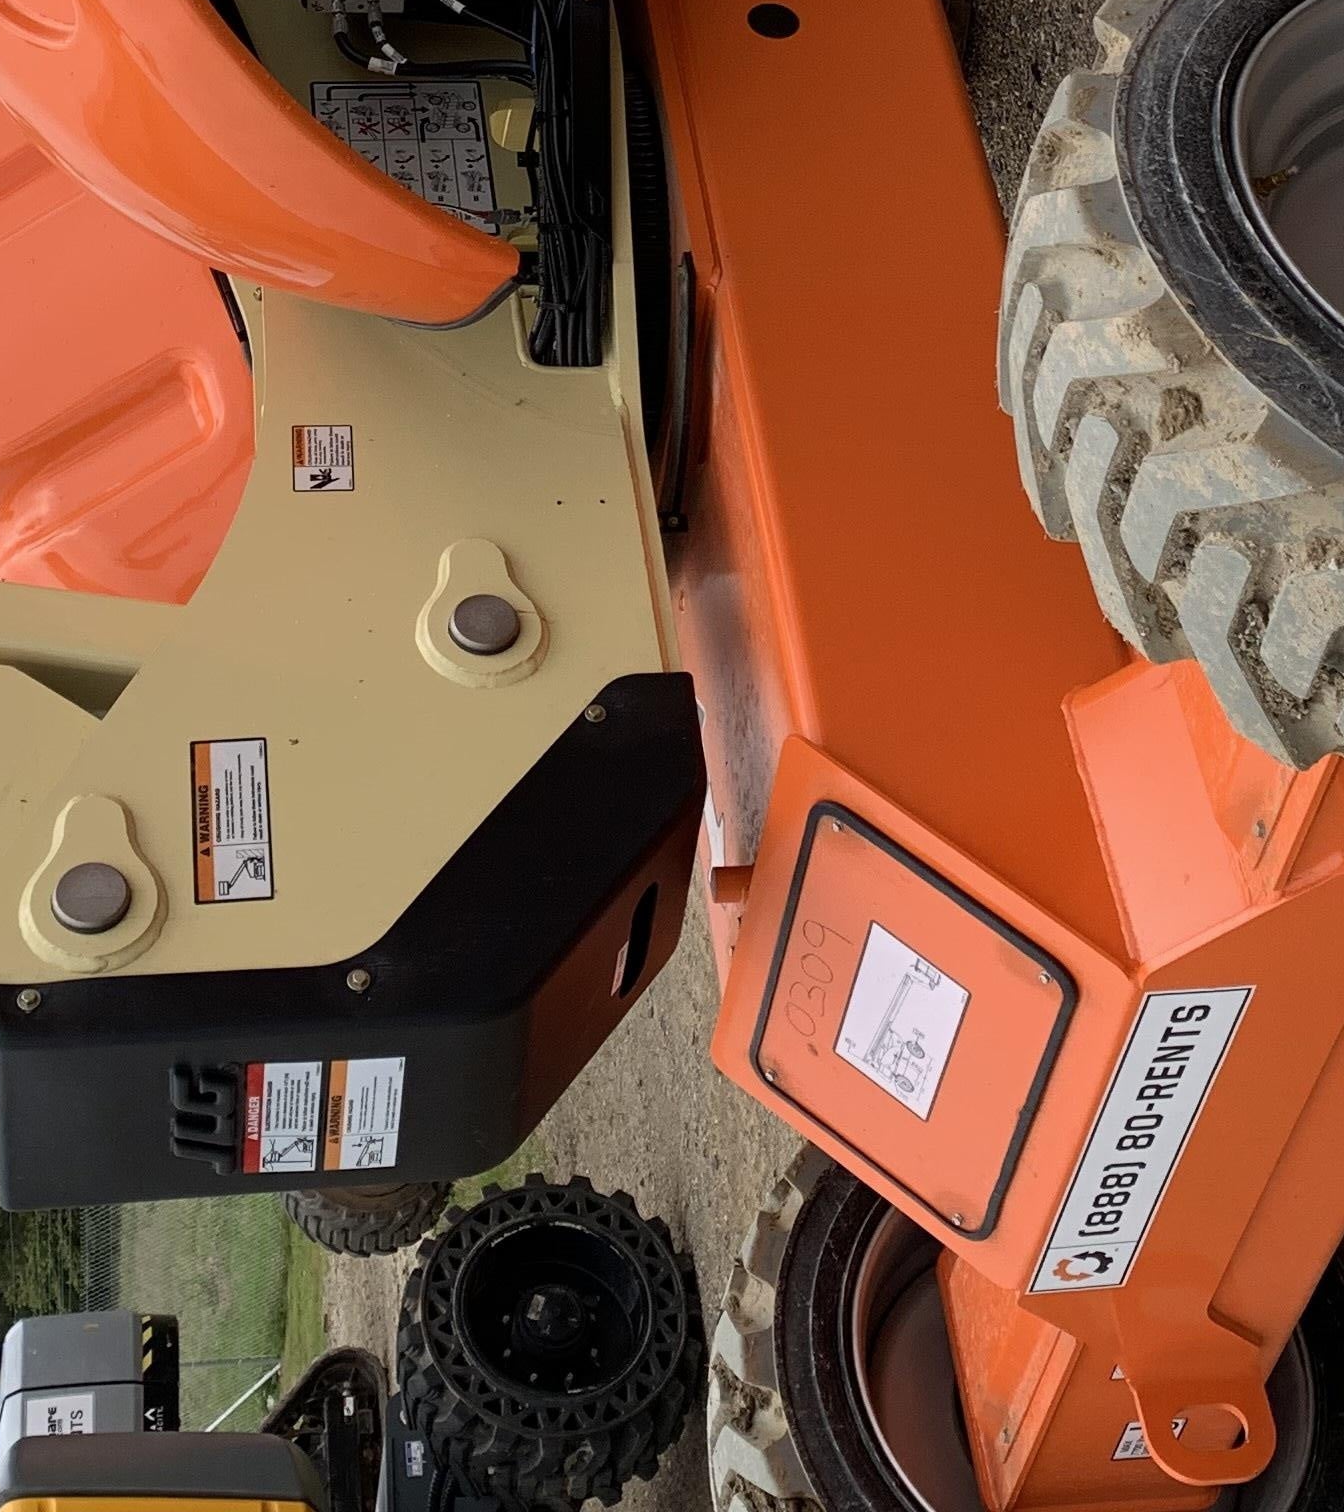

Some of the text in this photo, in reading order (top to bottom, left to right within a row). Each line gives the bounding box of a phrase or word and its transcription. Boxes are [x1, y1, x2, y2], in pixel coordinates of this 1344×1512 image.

[198, 785, 210, 843] WARNING
[784, 920, 854, 1037] 0309
[169, 1065, 237, 1176] JLG
[248, 1096, 260, 1132] DANGER
[329, 1095, 342, 1137] WARNING
[1078, 1004, 1212, 1237] (888) 80-RENTS
